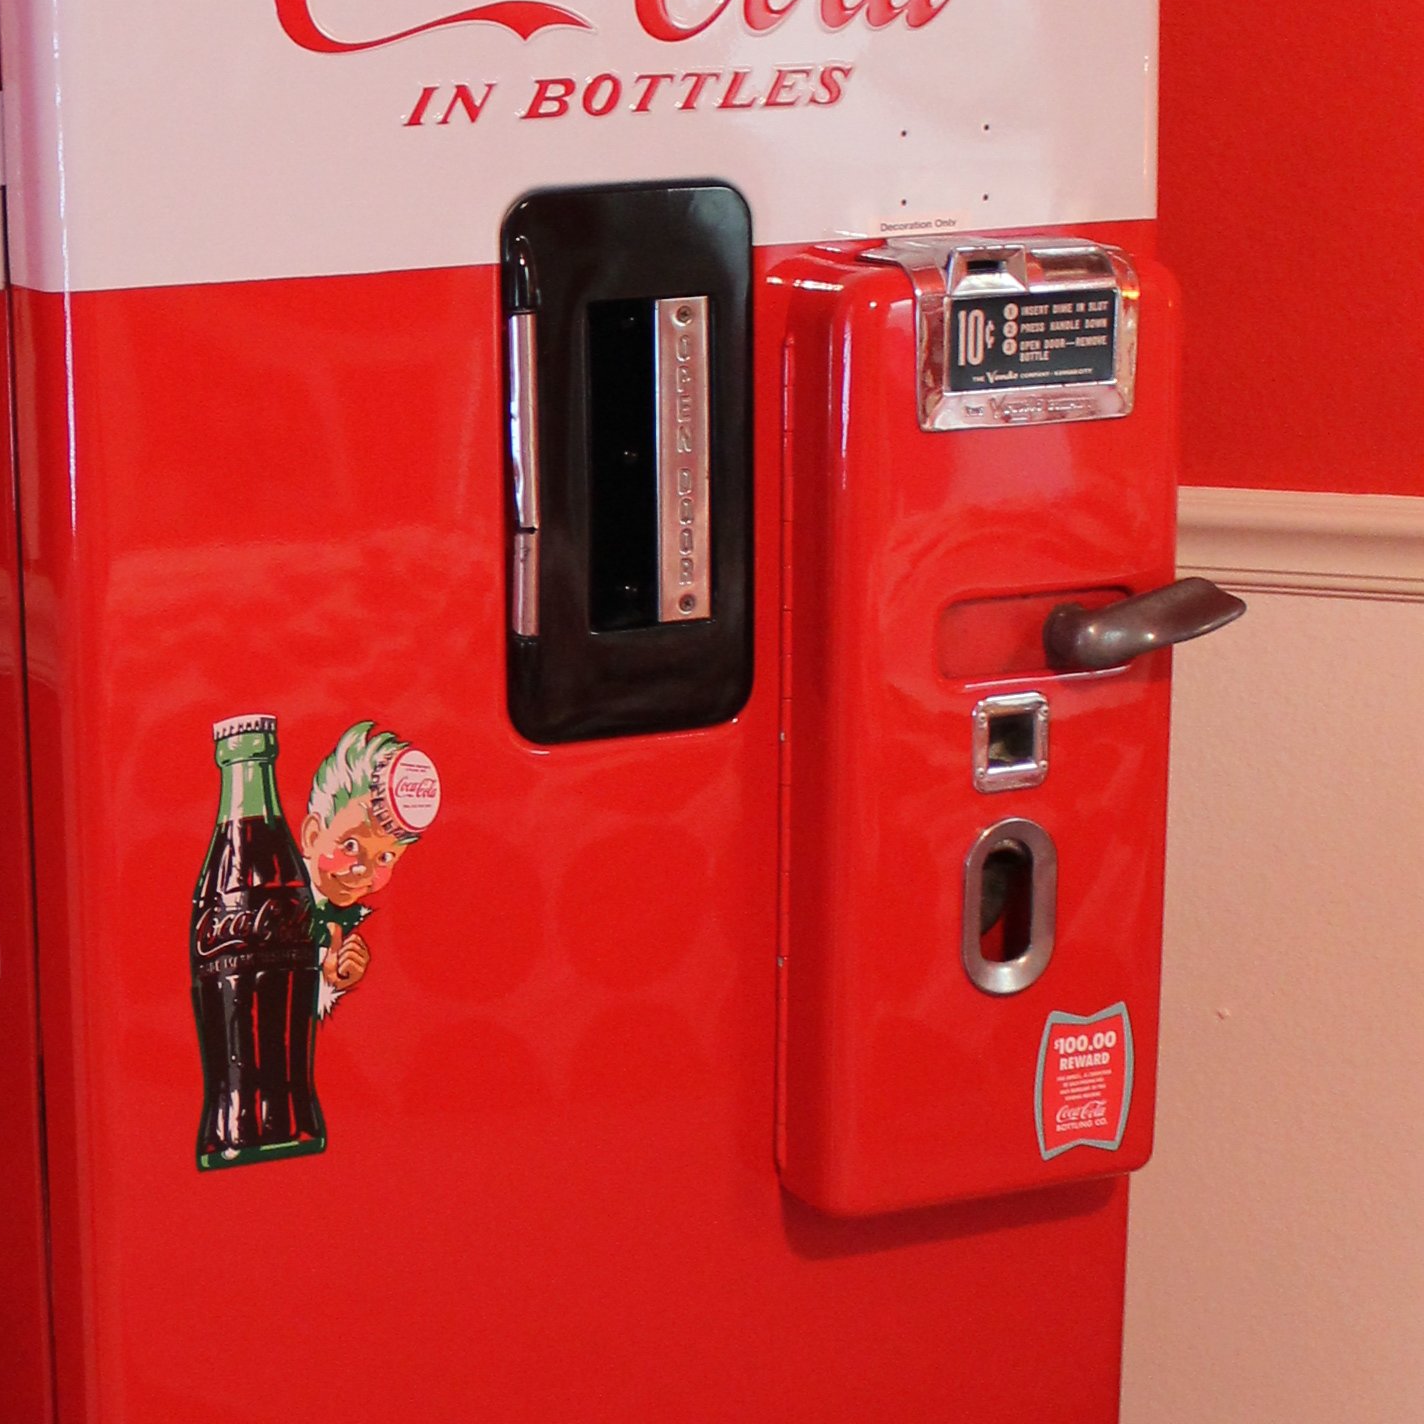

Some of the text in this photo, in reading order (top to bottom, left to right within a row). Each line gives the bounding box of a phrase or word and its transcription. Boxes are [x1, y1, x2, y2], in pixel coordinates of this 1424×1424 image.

[404, 63, 855, 128] IN BOTTLES
[880, 218, 956, 232] Decoration Only
[1021, 304, 1049, 316] INSERT
[1020, 350, 1050, 362] BOTTLE
[394, 776, 437, 798] Coca-Cola
[1053, 1031, 1117, 1055] $100.00
[1059, 1052, 1110, 1071] REWARD
